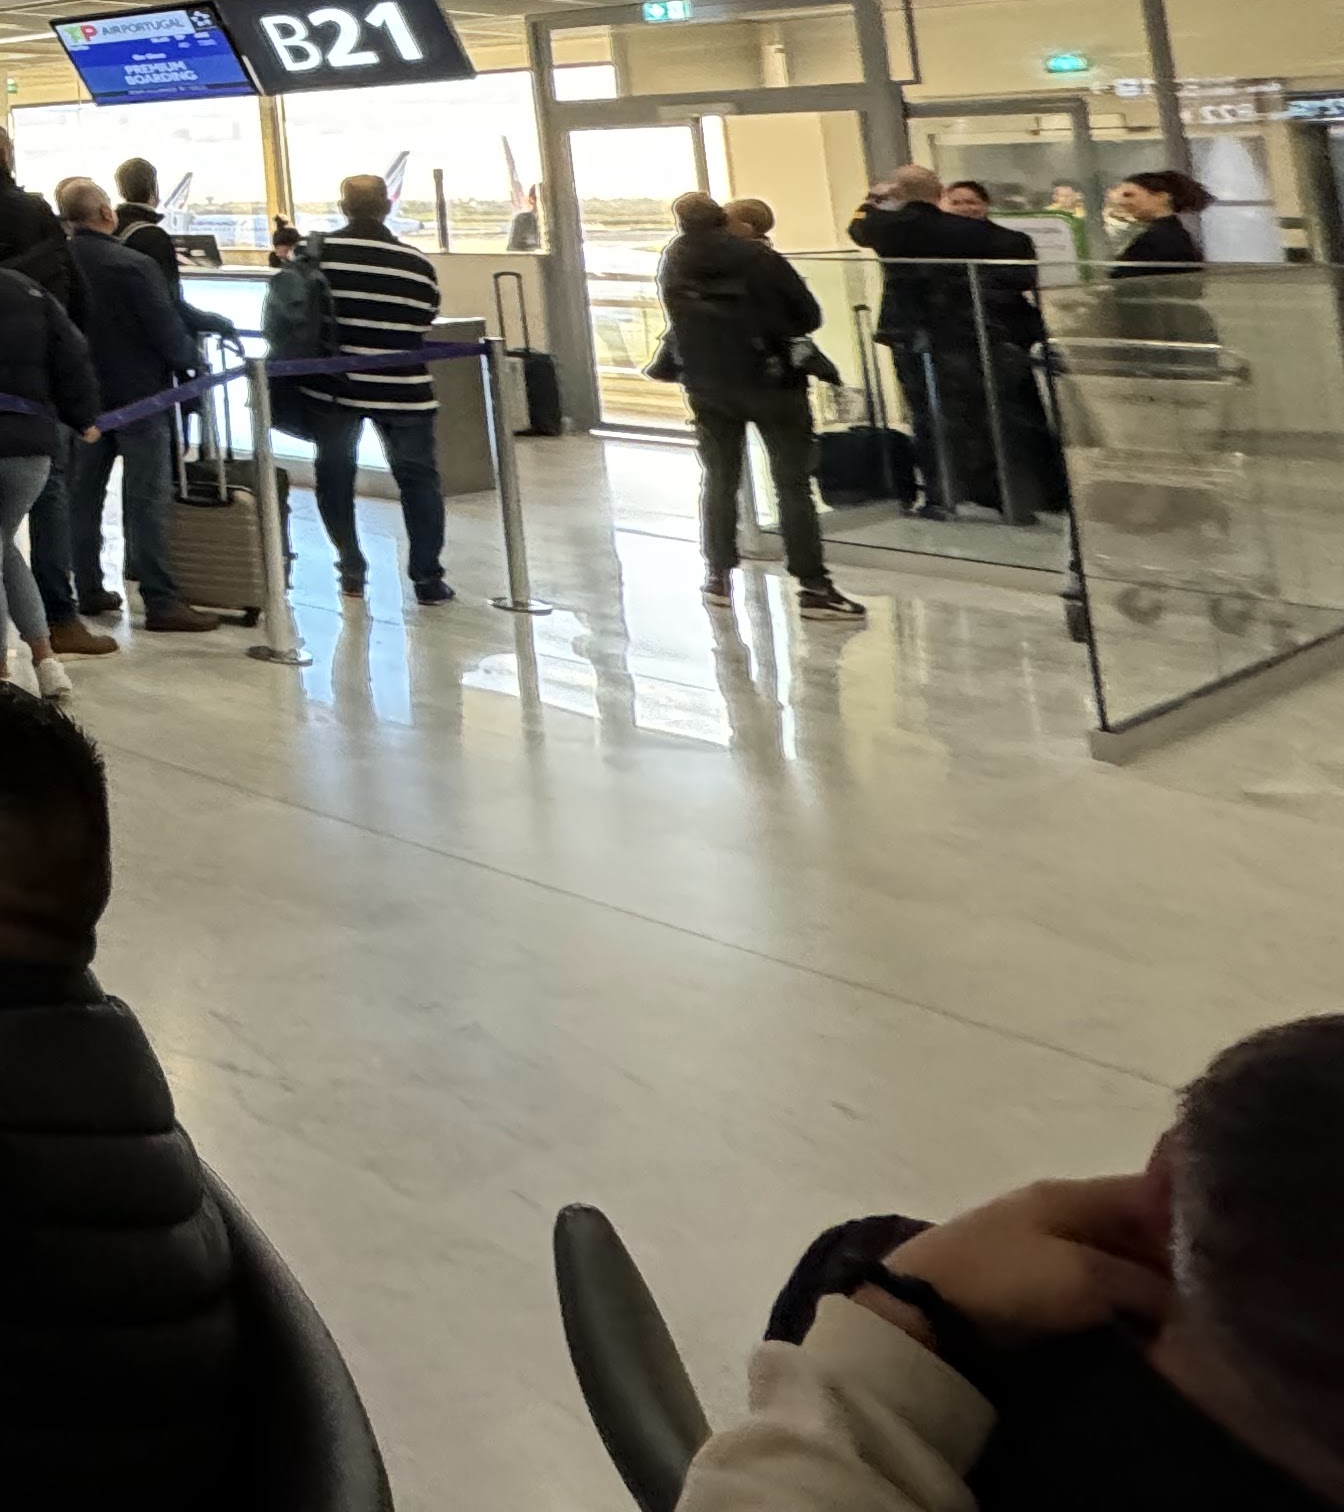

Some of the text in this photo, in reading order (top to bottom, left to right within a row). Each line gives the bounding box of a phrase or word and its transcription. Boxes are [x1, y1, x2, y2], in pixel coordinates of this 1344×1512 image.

[259, 1, 423, 71] B21
[124, 61, 187, 75] PREMIUM
[124, 70, 198, 85] BOARDING
